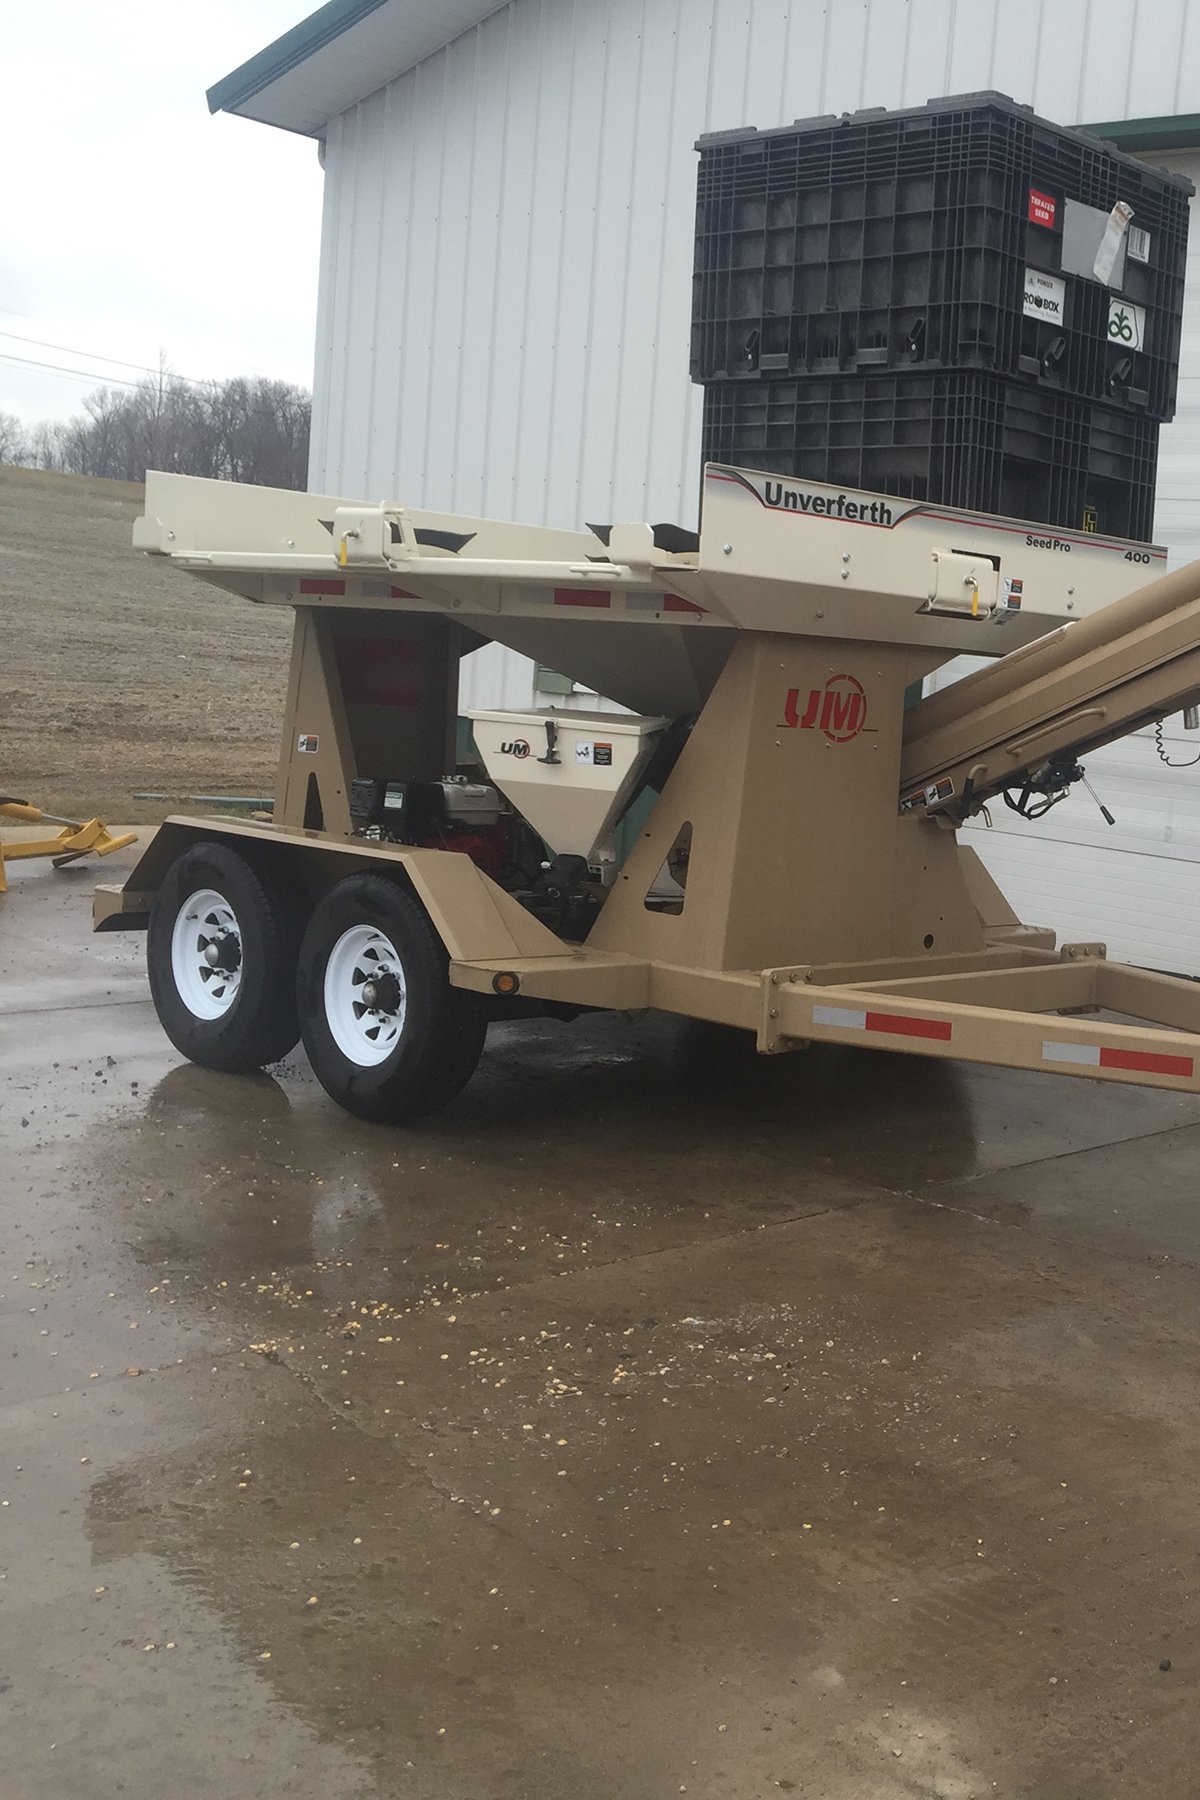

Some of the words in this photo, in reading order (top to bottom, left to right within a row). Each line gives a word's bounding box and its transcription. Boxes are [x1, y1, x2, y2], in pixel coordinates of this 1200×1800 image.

[1034, 208, 1049, 220] SEED
[765, 481, 892, 525] Unverferth
[1124, 551, 1150, 564] 400
[500, 742, 528, 755] UM
